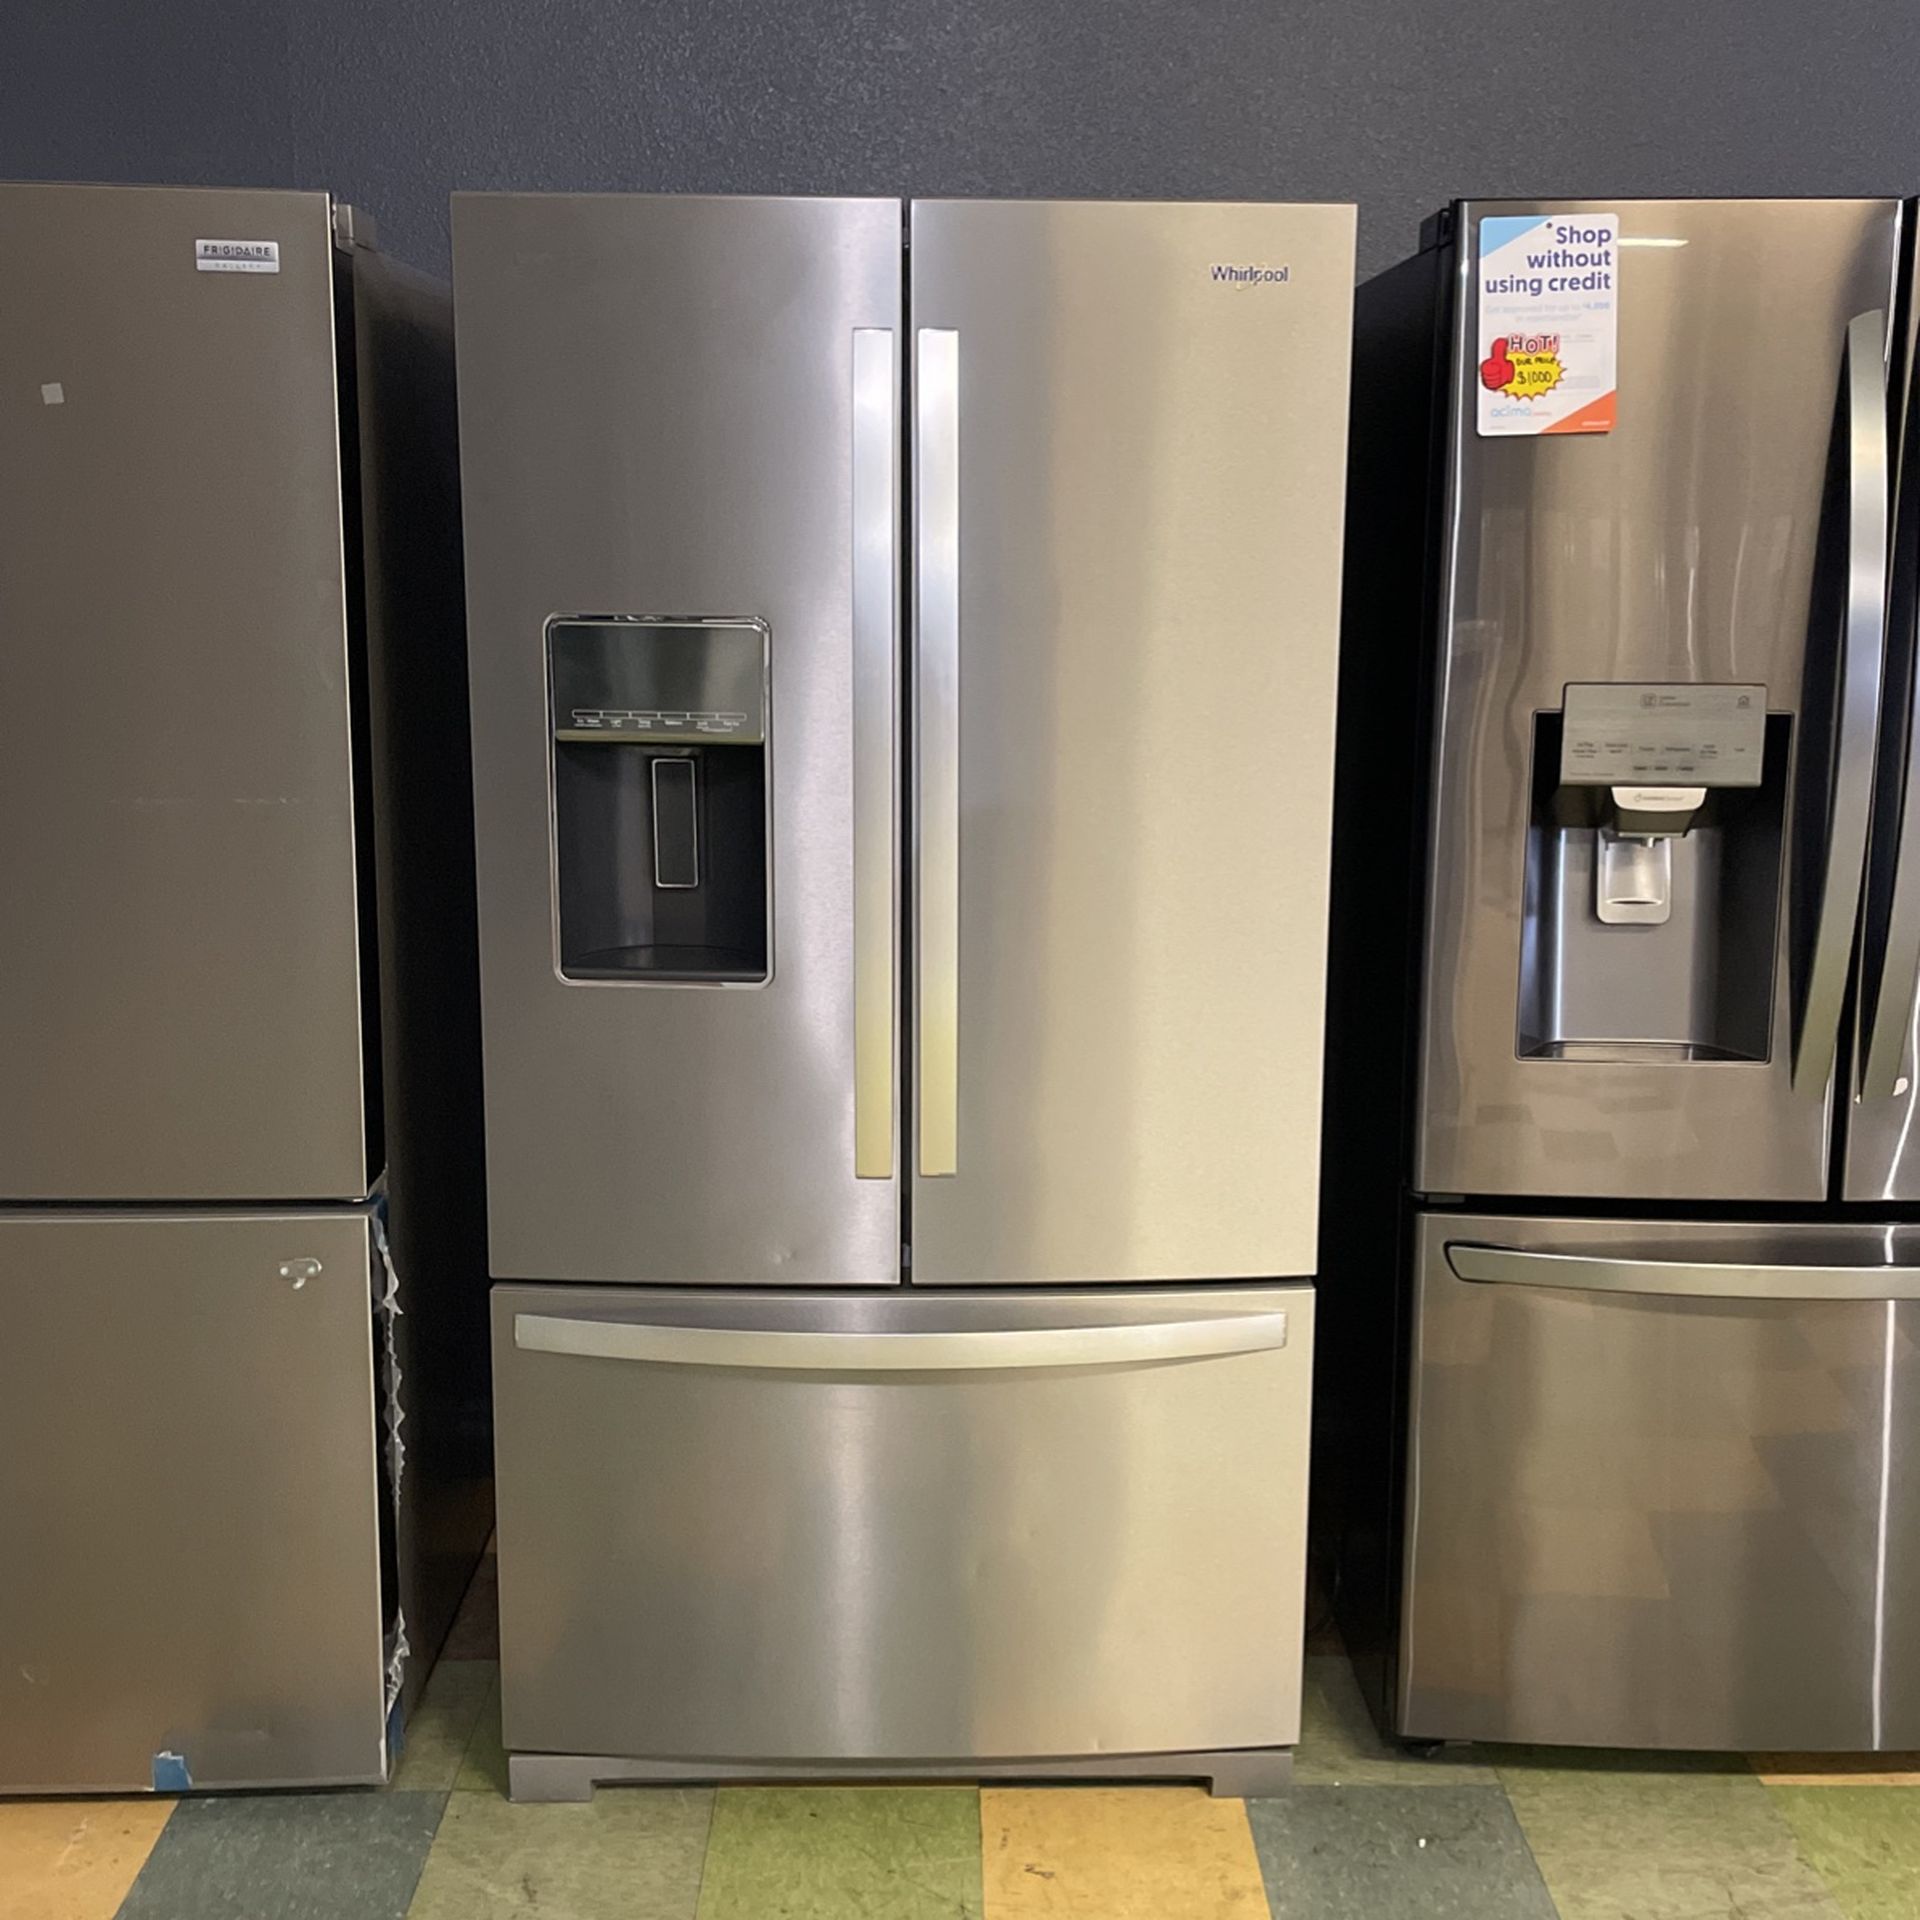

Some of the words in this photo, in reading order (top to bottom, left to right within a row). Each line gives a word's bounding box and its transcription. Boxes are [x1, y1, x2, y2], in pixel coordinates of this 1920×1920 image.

[1556, 226, 1612, 247] Shop
[203, 245, 271, 256] FRIGIDAIRE
[1526, 249, 1612, 268] without
[1211, 266, 1289, 286] Whirlpool
[1485, 274, 1543, 297] using
[1548, 271, 1611, 291] credit
[1510, 335, 1558, 354] HOT!
[1516, 371, 1552, 386] $1000
